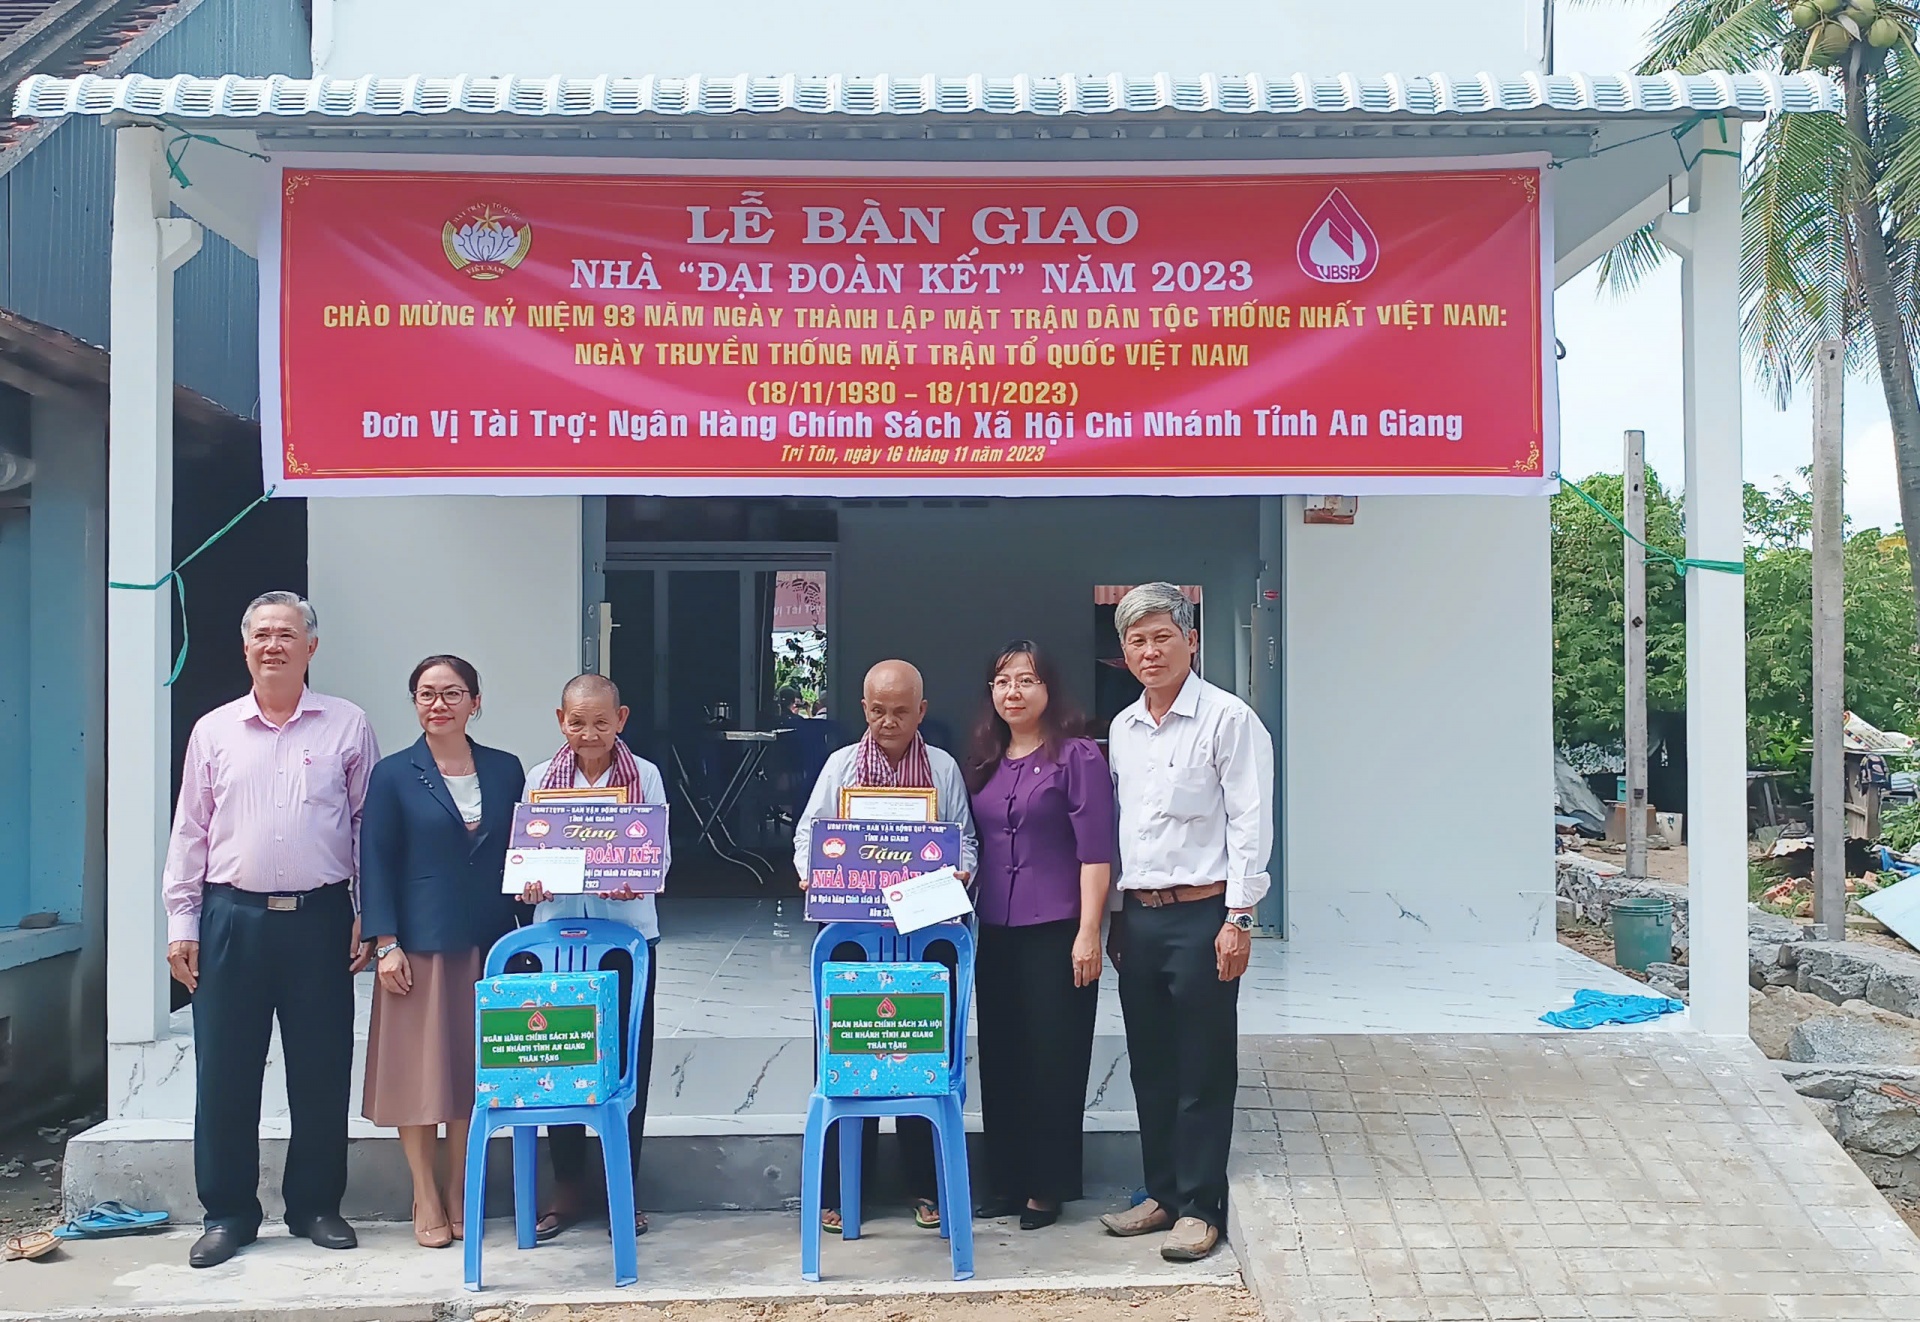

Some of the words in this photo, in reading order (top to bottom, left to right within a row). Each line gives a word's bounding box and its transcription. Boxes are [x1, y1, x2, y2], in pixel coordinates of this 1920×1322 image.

[687, 191, 775, 243] LỄ
[802, 199, 945, 243] BÀN
[972, 206, 1138, 244] GIAO
[570, 253, 661, 289] NHÀ
[680, 262, 773, 299] “ĐẠI
[788, 254, 904, 293] ĐOÀN
[919, 247, 1024, 293] KẾT”
[1042, 255, 1136, 293] NĂM
[1152, 261, 1252, 291] 2023
[324, 300, 389, 327] CHÀO
[400, 300, 474, 326] MỪNG
[484, 298, 516, 327] KỶ
[529, 301, 594, 332] NIỆM
[604, 305, 635, 326] 93
[645, 302, 703, 326] NĂM
[714, 303, 783, 327] NGÀY
[794, 304, 877, 328] THÀNH
[888, 305, 934, 334] LẬP
[945, 306, 1000, 334] MẶT
[1011, 305, 1077, 334] TRẬN
[1088, 304, 1139, 328] DÂN
[1149, 304, 1198, 332] TỘC
[1208, 299, 1290, 328] THỐNG
[1300, 300, 1366, 327] NHẤT
[1377, 300, 1434, 330] VIỆT
[1444, 304, 1506, 326] NAM:
[575, 338, 644, 365] NGÀY
[655, 335, 757, 365] TRUYỀN
[768, 337, 851, 365] THỐNG
[861, 341, 917, 370] MẶT
[928, 341, 994, 370] TRẬN
[1005, 336, 1038, 365] TỔ
[1048, 338, 1114, 368] QUỐC
[1125, 339, 1182, 370] VIỆT
[1192, 344, 1248, 366] NAM
[748, 382, 895, 405] (18/11/1930
[926, 382, 1078, 406] 18/11/2023)
[362, 412, 417, 437] Đơn
[431, 410, 457, 443] Vị
[470, 409, 517, 436] Tài
[530, 411, 596, 443] Trợ:
[609, 410, 687, 440] Ngân
[700, 410, 776, 441] Hàng
[789, 411, 872, 437] Chính
[885, 410, 960, 438] Sách
[974, 411, 1011, 438] Xã
[1026, 412, 1073, 445] Hội
[1086, 412, 1132, 438] Chi
[1144, 410, 1240, 436] Nhánh
[1254, 405, 1316, 436] Tỉnh
[1329, 410, 1367, 435] An
[1380, 409, 1462, 440] Giang
[782, 445, 804, 461] Tri
[808, 445, 838, 464] Tôn,
[844, 449, 882, 464] ngày
[887, 446, 903, 462] 16
[907, 446, 949, 464] tháng
[954, 446, 968, 461] 11
[971, 446, 1003, 462] năm
[1006, 446, 1045, 461] 2023
[563, 825, 618, 841] Tặng
[628, 839, 661, 865] KẾT
[858, 844, 913, 864] Tặng
[811, 863, 845, 889] NHÀ
[848, 870, 877, 893] ĐẠI
[879, 866, 921, 889] ĐOÀ
